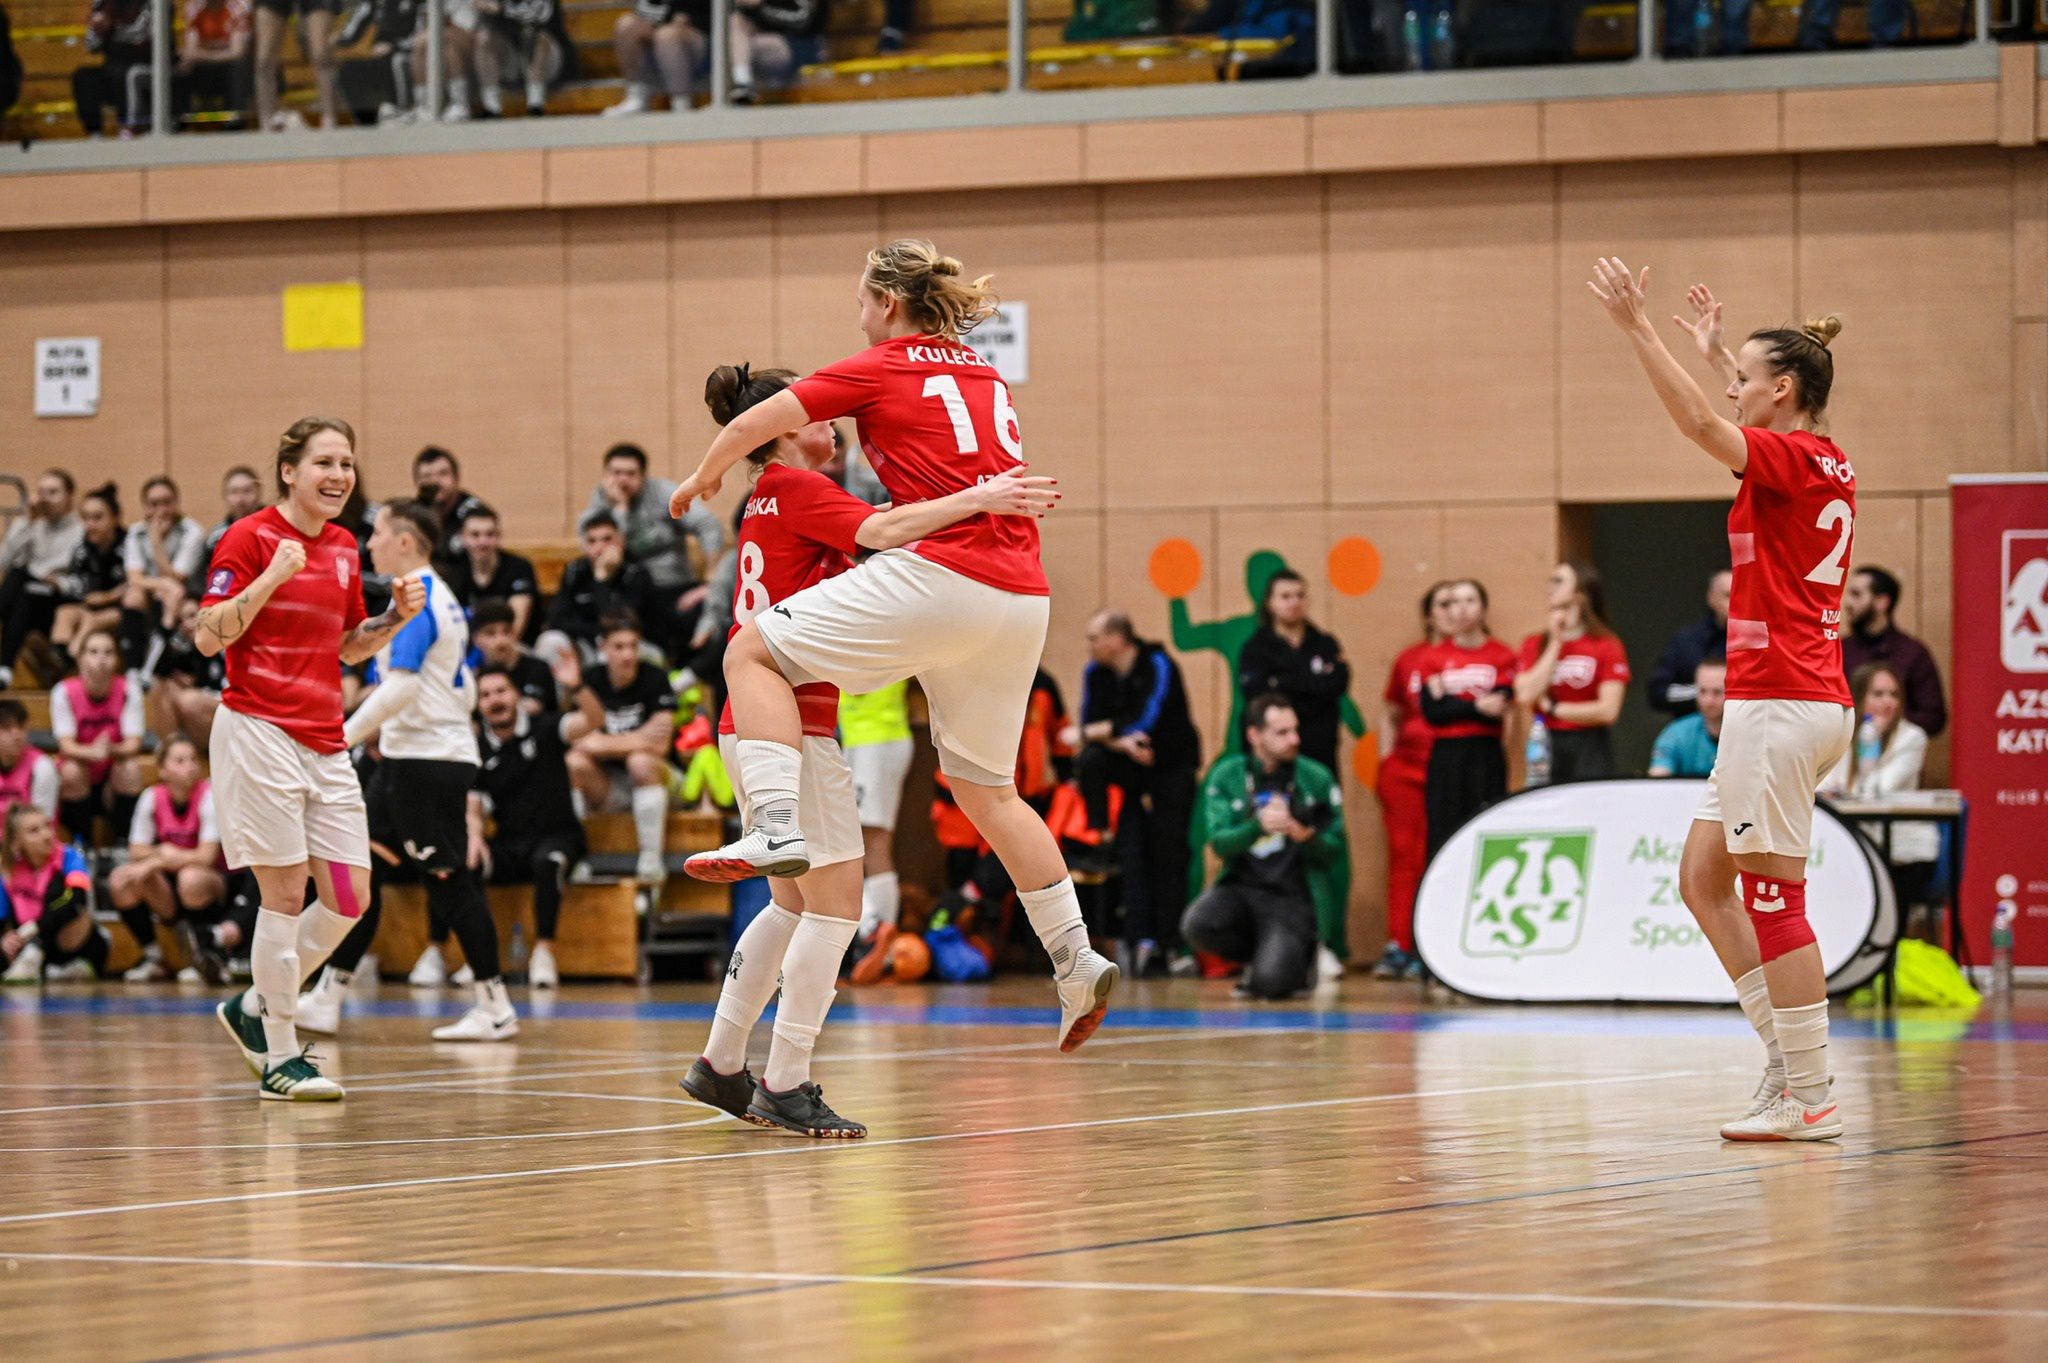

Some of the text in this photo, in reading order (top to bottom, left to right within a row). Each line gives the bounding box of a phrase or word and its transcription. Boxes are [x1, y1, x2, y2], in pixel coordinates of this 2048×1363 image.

[906, 346, 994, 368] KULECZ
[921, 374, 1022, 461] 16
[735, 541, 770, 627] 8
[1996, 728, 2048, 754] KAT
